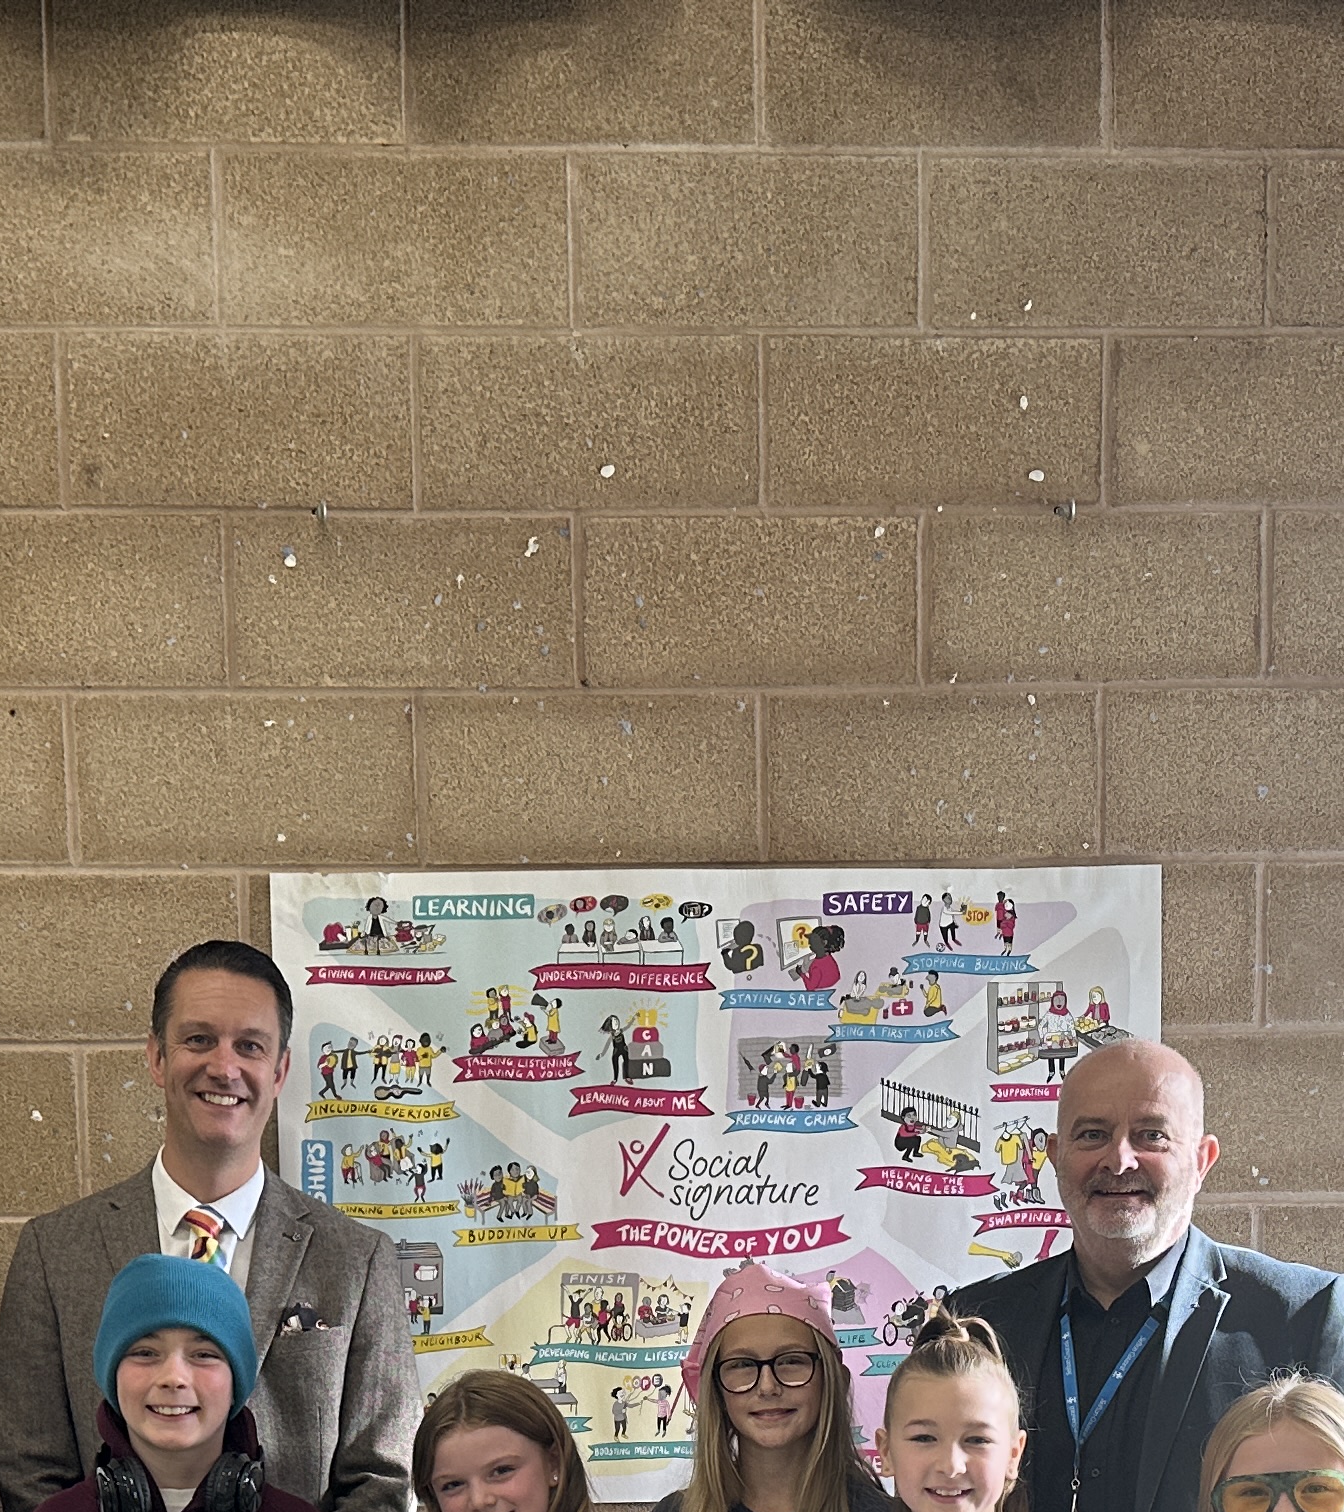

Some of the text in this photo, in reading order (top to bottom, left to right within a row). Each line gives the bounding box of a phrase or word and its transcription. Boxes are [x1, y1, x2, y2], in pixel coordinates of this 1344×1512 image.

[413, 897, 533, 918] LEARNING
[828, 894, 909, 914] SAFETY
[966, 911, 990, 922] STOP
[912, 957, 1027, 971] STOPPING BULLYING
[318, 968, 446, 982] GIVING A HELPING HAND
[539, 970, 704, 986] UNDERSTANDING DIFFERENCE
[729, 993, 825, 1007] STAYING SAFE
[835, 1026, 949, 1039] BEING A FIRST AIDER
[517, 1057, 573, 1070] LISTENING
[464, 1068, 572, 1079] & HAVING A VOICE
[580, 1091, 696, 1109] LEARNING ABOUT ME
[996, 1087, 1050, 1098] SUPPORTING
[313, 1102, 451, 1119] INCLUDING EVERYONE
[735, 1111, 846, 1126] REDUCING CRIME
[668, 1138, 769, 1181] Social
[881, 1169, 964, 1186] HELPING THE
[886, 1179, 965, 1195] HOMELESS
[669, 1174, 819, 1221] signature
[339, 1203, 456, 1215] LINKING GENERATIONS
[988, 1210, 1051, 1228] SWAPPING
[468, 1226, 568, 1243] BUDDYING UP
[616, 1222, 822, 1255] THE POWER OF YOU
[569, 1274, 627, 1284] FINISH
[420, 1331, 484, 1348] NEIGHBOUR
[839, 1334, 865, 1344] LIFE
[538, 1348, 590, 1360] DEVELOPING
[594, 1351, 637, 1362] HEALTHY
[594, 1447, 631, 1456] BOOSTING
[634, 1445, 669, 1456] MENTAL
